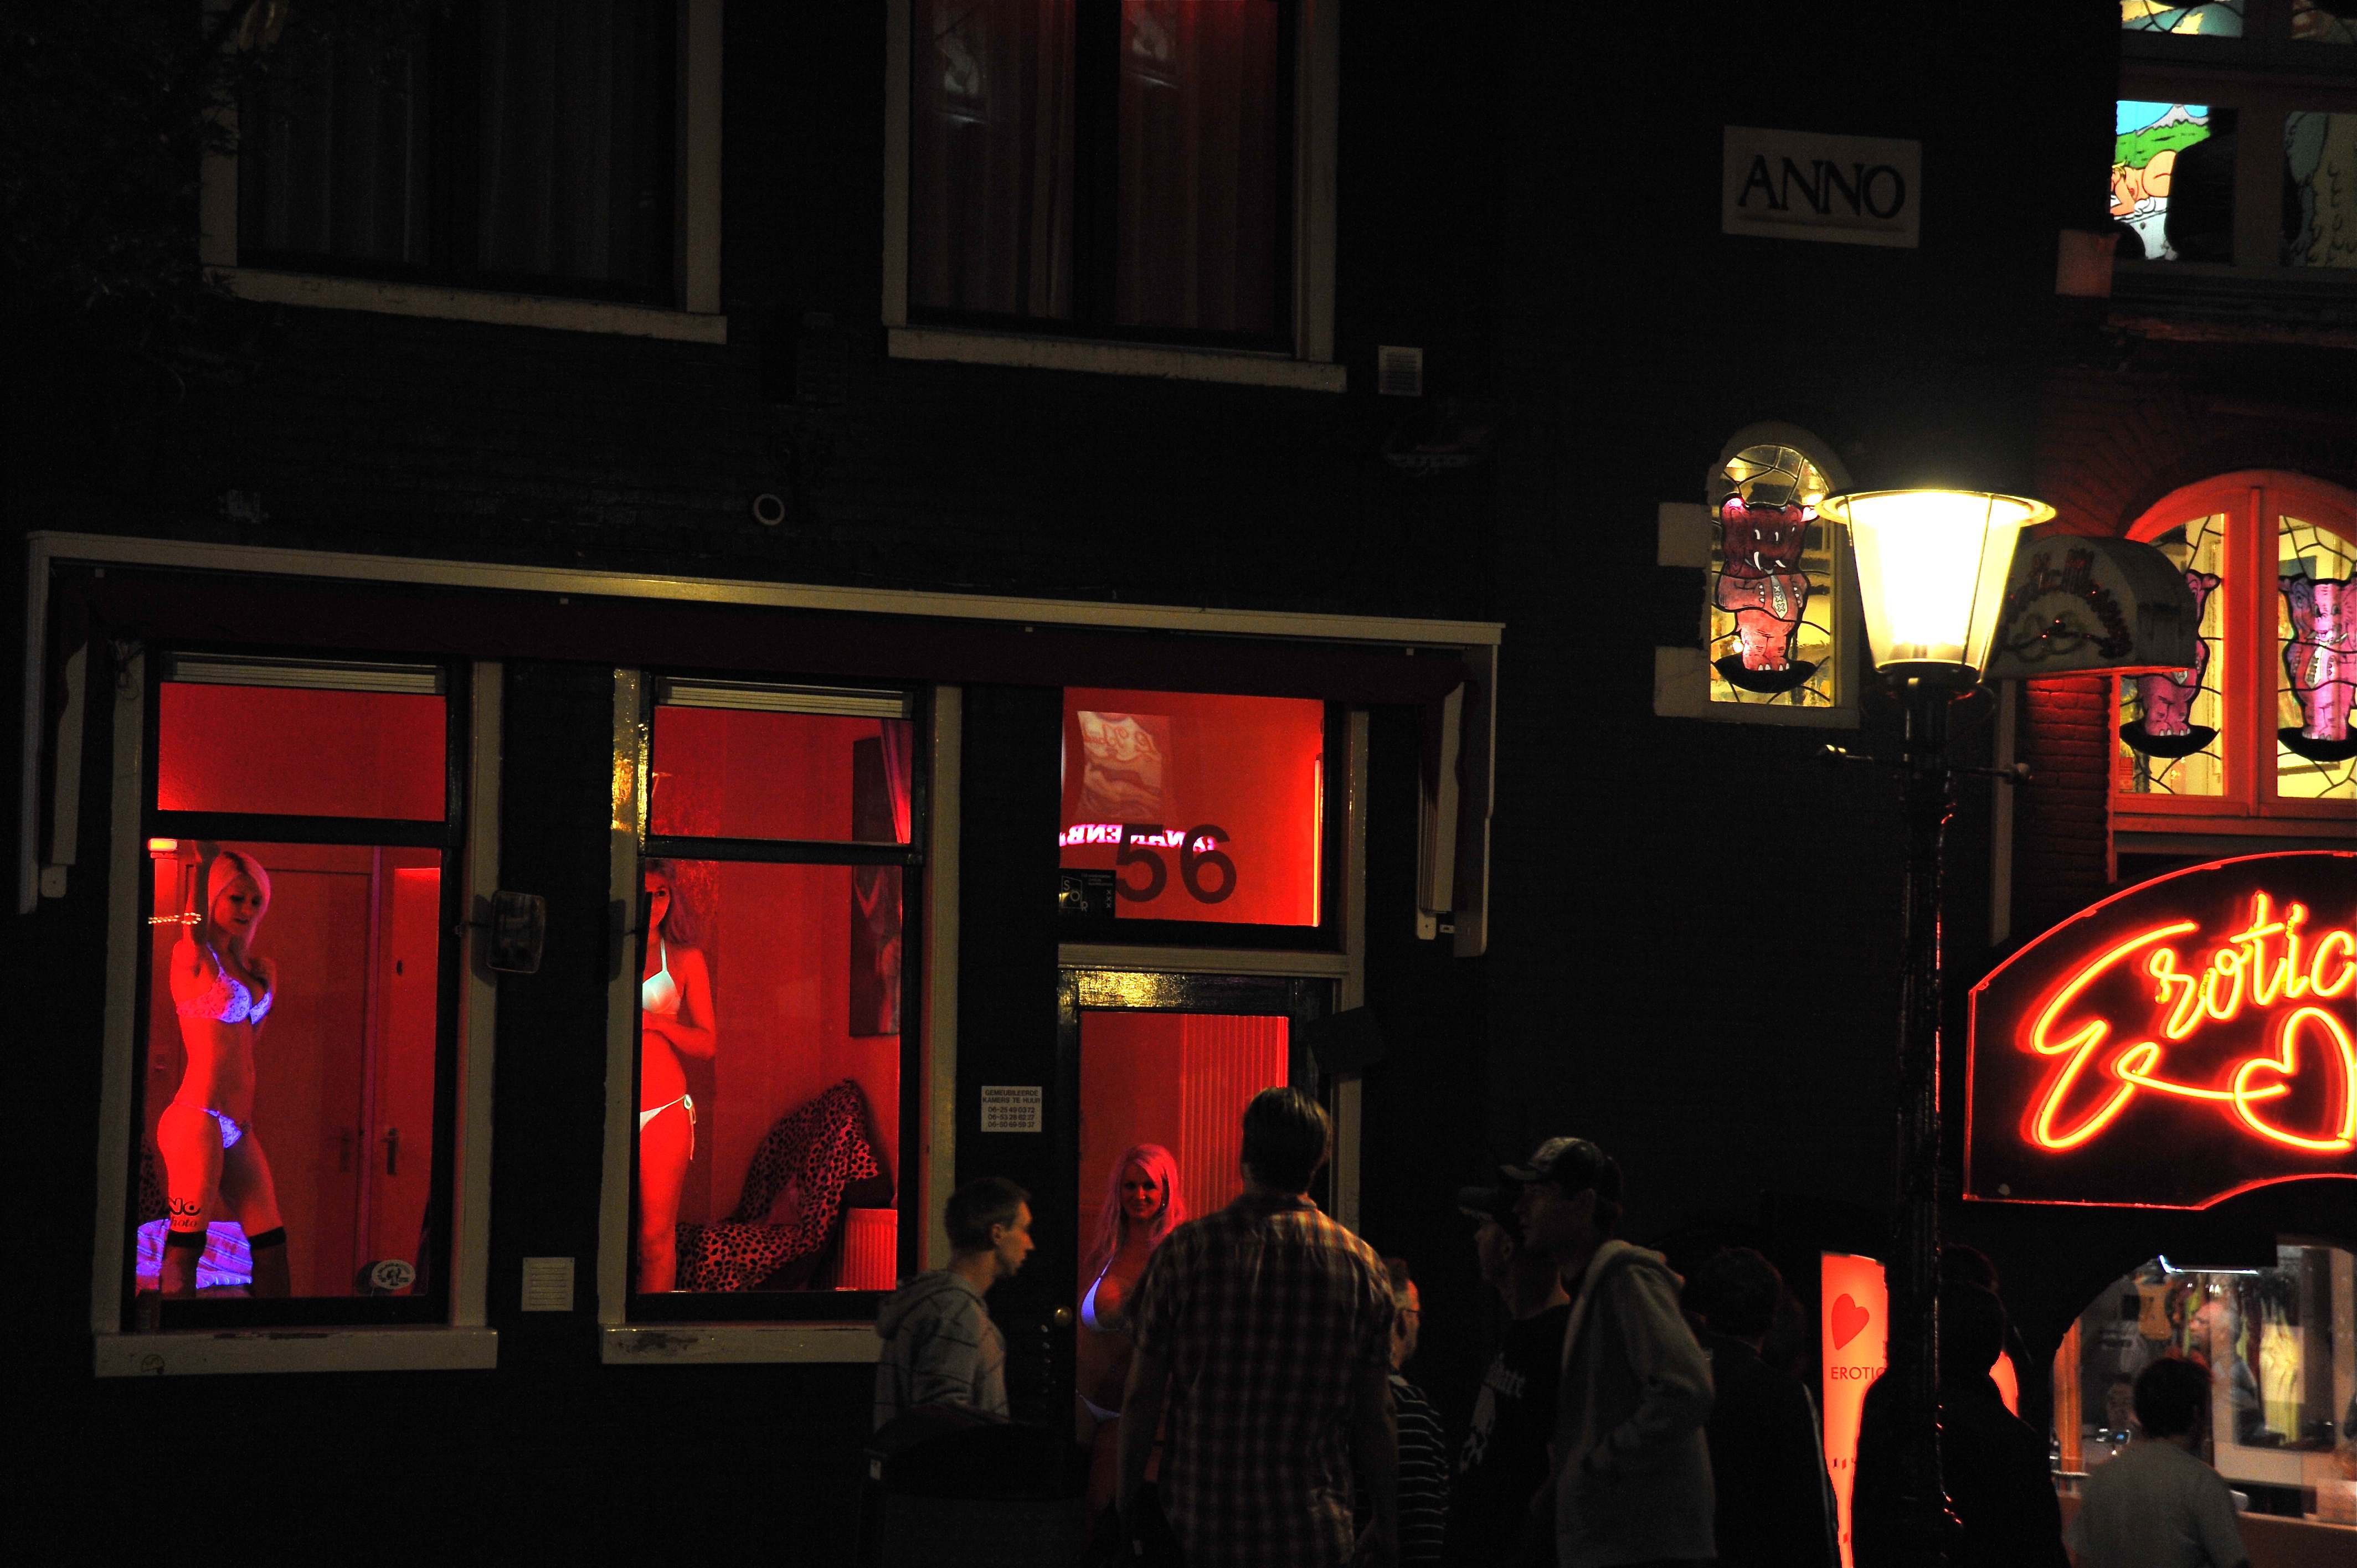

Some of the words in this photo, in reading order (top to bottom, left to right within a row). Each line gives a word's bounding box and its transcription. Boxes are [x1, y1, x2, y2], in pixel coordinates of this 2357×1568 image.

[1738, 154, 1906, 219] ANNO
[1114, 823, 1237, 904] 56
[2030, 889, 2357, 1151] Erotic
[171, 1216, 198, 1227] hoto
